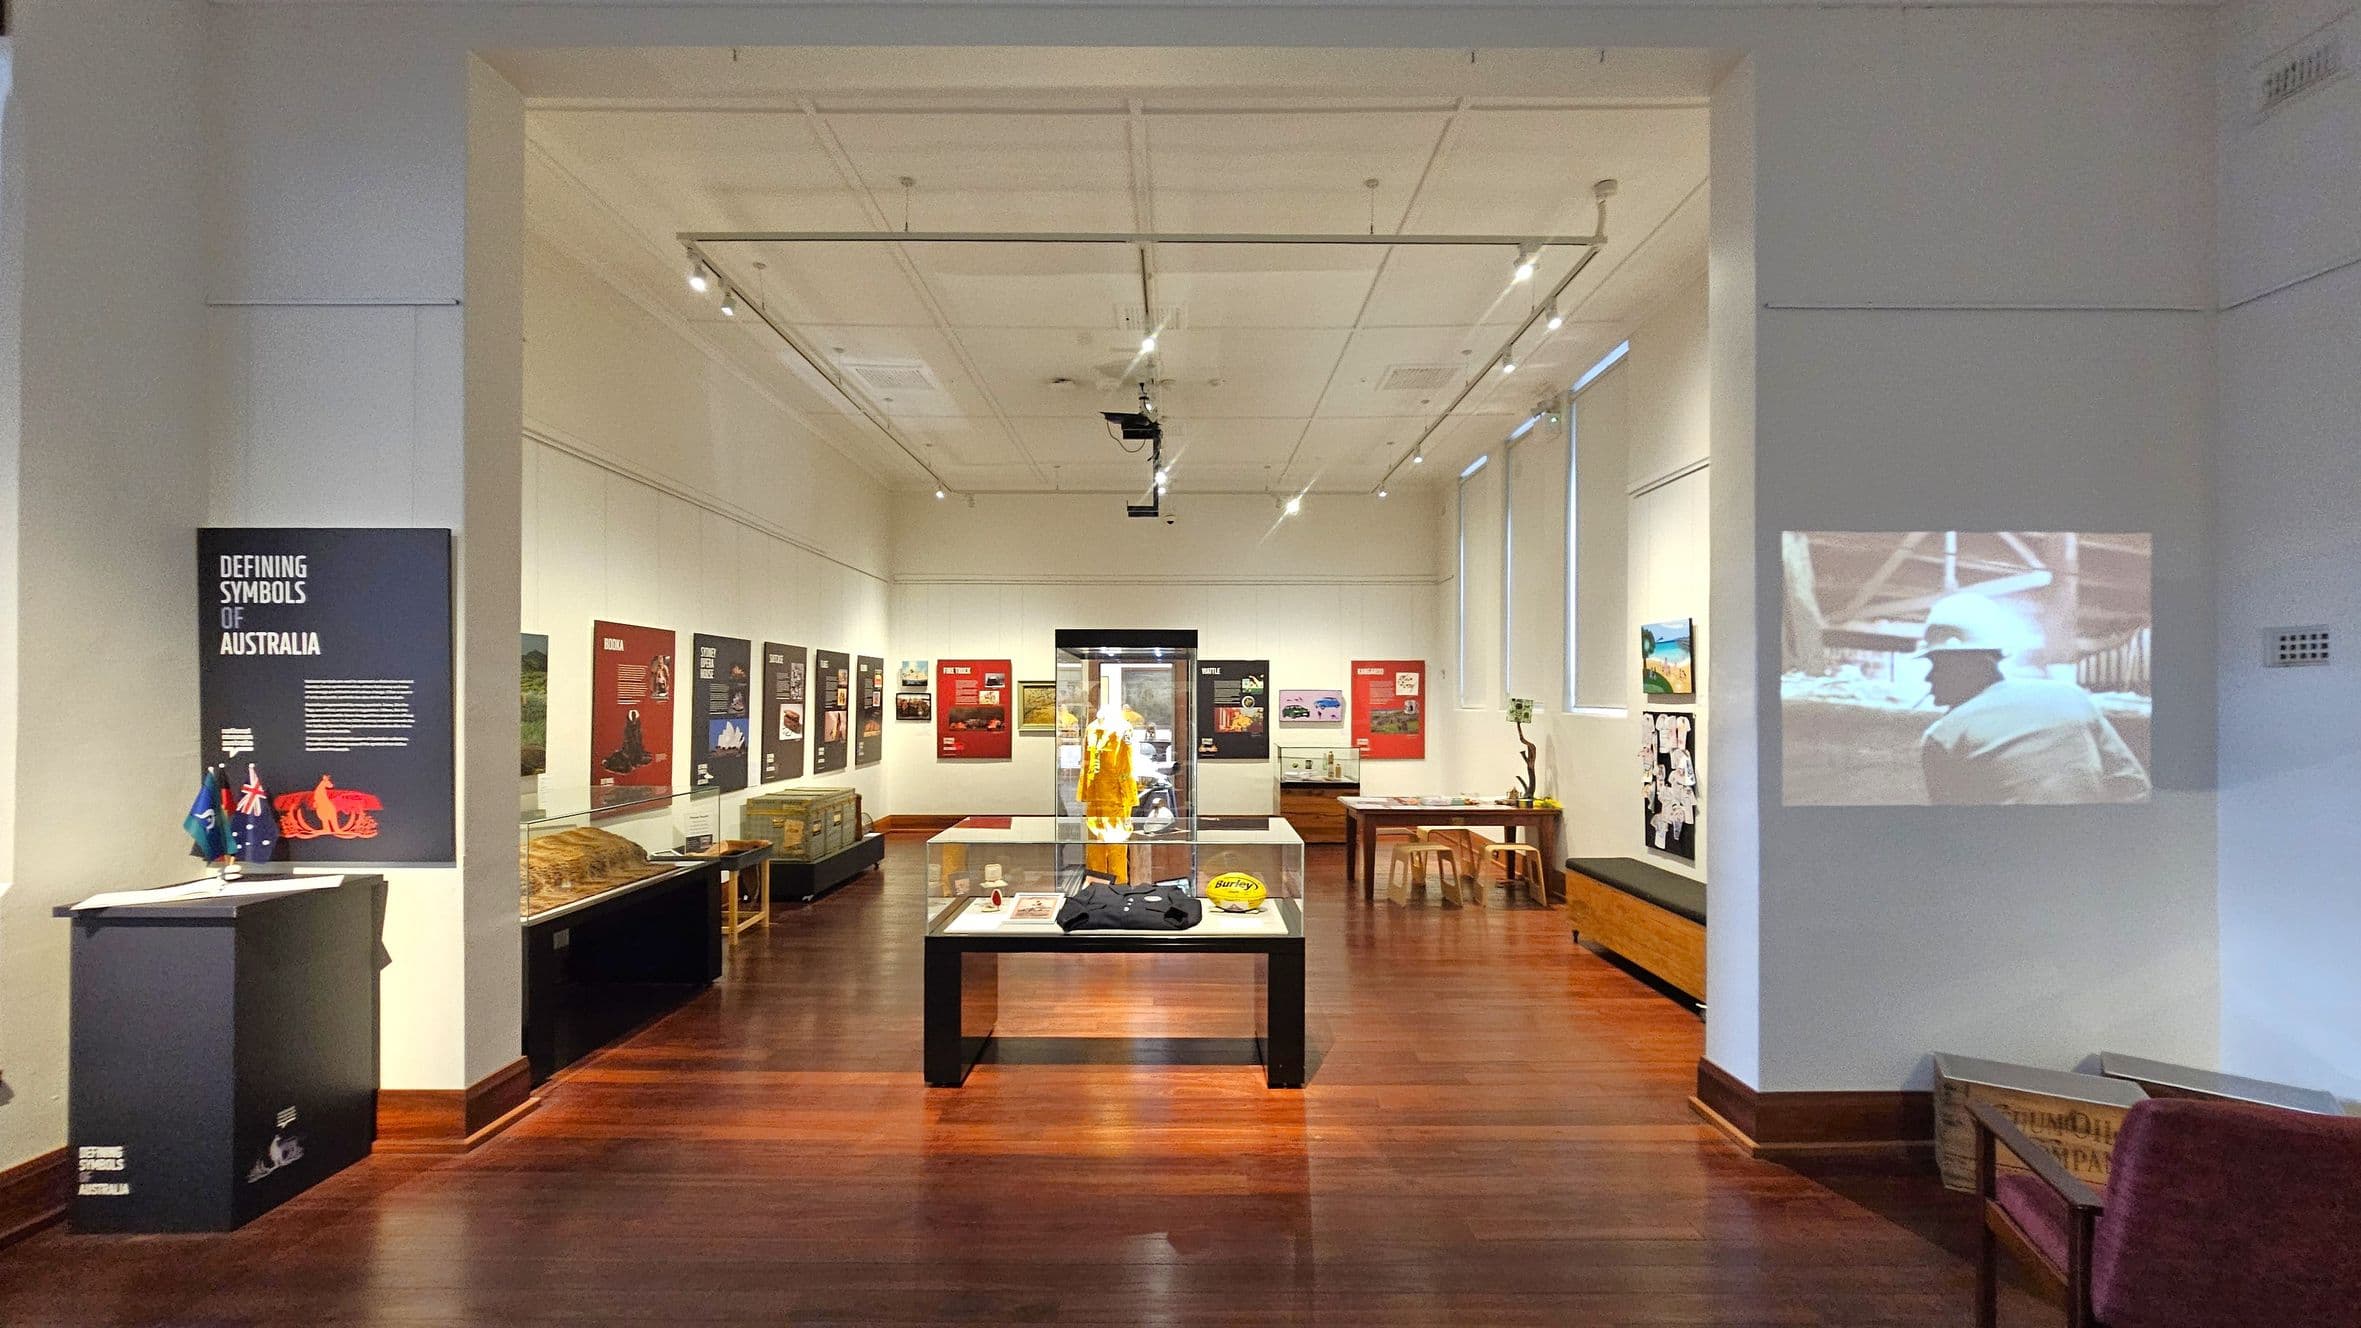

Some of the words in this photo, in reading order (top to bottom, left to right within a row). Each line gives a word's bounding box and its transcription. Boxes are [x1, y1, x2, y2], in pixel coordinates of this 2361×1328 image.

[220, 555, 307, 578] DEFINING
[220, 581, 306, 604] SYMBOLS
[221, 607, 244, 629] OF
[220, 632, 321, 655] AUSTRALIA
[604, 638, 624, 651] BOOKA
[700, 658, 715, 669] OPERA
[1201, 667, 1221, 675] WATTLE
[1215, 880, 1253, 891] Burley
[78, 1158, 126, 1171] SYMBOLS
